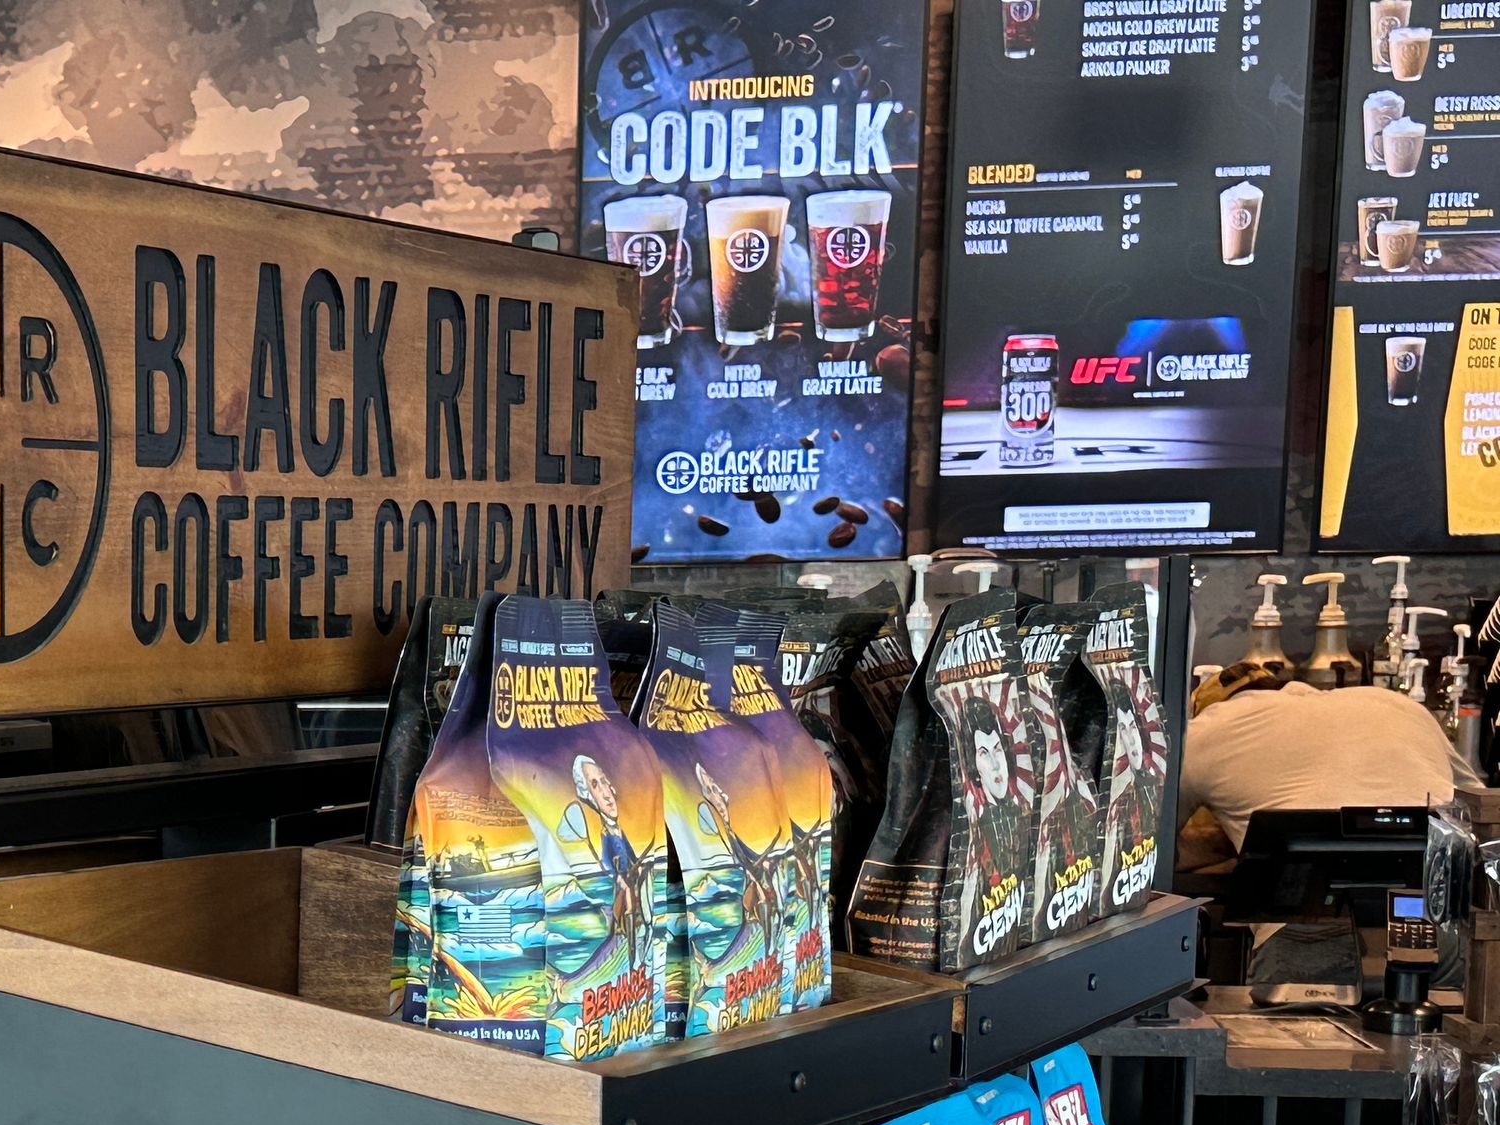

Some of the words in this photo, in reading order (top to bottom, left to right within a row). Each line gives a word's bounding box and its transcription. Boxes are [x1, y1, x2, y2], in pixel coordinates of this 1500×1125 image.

[1441, 2, 1485, 20] LIBERTY
[1083, 20, 1123, 37] MOCHA
[1124, 20, 1152, 35] COLD
[1154, 19, 1186, 34] BREW
[1188, 17, 1219, 33] LATTE
[1149, 39, 1184, 54] DRAFT
[1185, 38, 1216, 53] LATTE
[1081, 61, 1124, 77] ARNOLD
[1126, 59, 1170, 76] PALMER
[689, 75, 814, 101] INTRODUCING
[610, 107, 764, 185] CODE
[779, 102, 894, 178] BLK
[968, 164, 1035, 184] BLENDED
[966, 200, 1006, 215] MOCHA
[1428, 193, 1447, 208] JET
[1449, 192, 1475, 207] FUEL
[965, 219, 986, 235] SEA
[987, 218, 1012, 234] SALT
[1014, 217, 1051, 233] TOFFEE
[964, 240, 1008, 255] VANILLA
[1471, 308, 1491, 324] ON
[1469, 337, 1497, 350] CODE
[134, 244, 397, 478] BLACK
[425, 288, 605, 486] RIFLE
[818, 360, 868, 378] VANILLA
[1070, 356, 1141, 384] UFC
[1181, 355, 1217, 370] BLACK
[1218, 354, 1250, 369] RIFLE
[1468, 356, 1495, 368] CODE
[706, 380, 738, 399] COLD
[741, 380, 777, 397] BREW
[802, 377, 842, 396] DRAFT
[844, 376, 883, 394] LATTE
[1008, 392, 1051, 422] 300
[700, 450, 762, 476] BLACK
[767, 449, 820, 473] RIFLE
[699, 475, 750, 494] COFFEE
[752, 474, 820, 493] COMPANY
[131, 490, 354, 647] COFFEE
[373, 498, 604, 636] COMPANY
[515, 665, 557, 702] BLACK
[560, 666, 598, 702] RIFLE
[516, 704, 554, 729] COFFEE
[901, 916, 919, 927] the
[491, 1027, 513, 1041] the
[516, 1027, 541, 1041] USA
